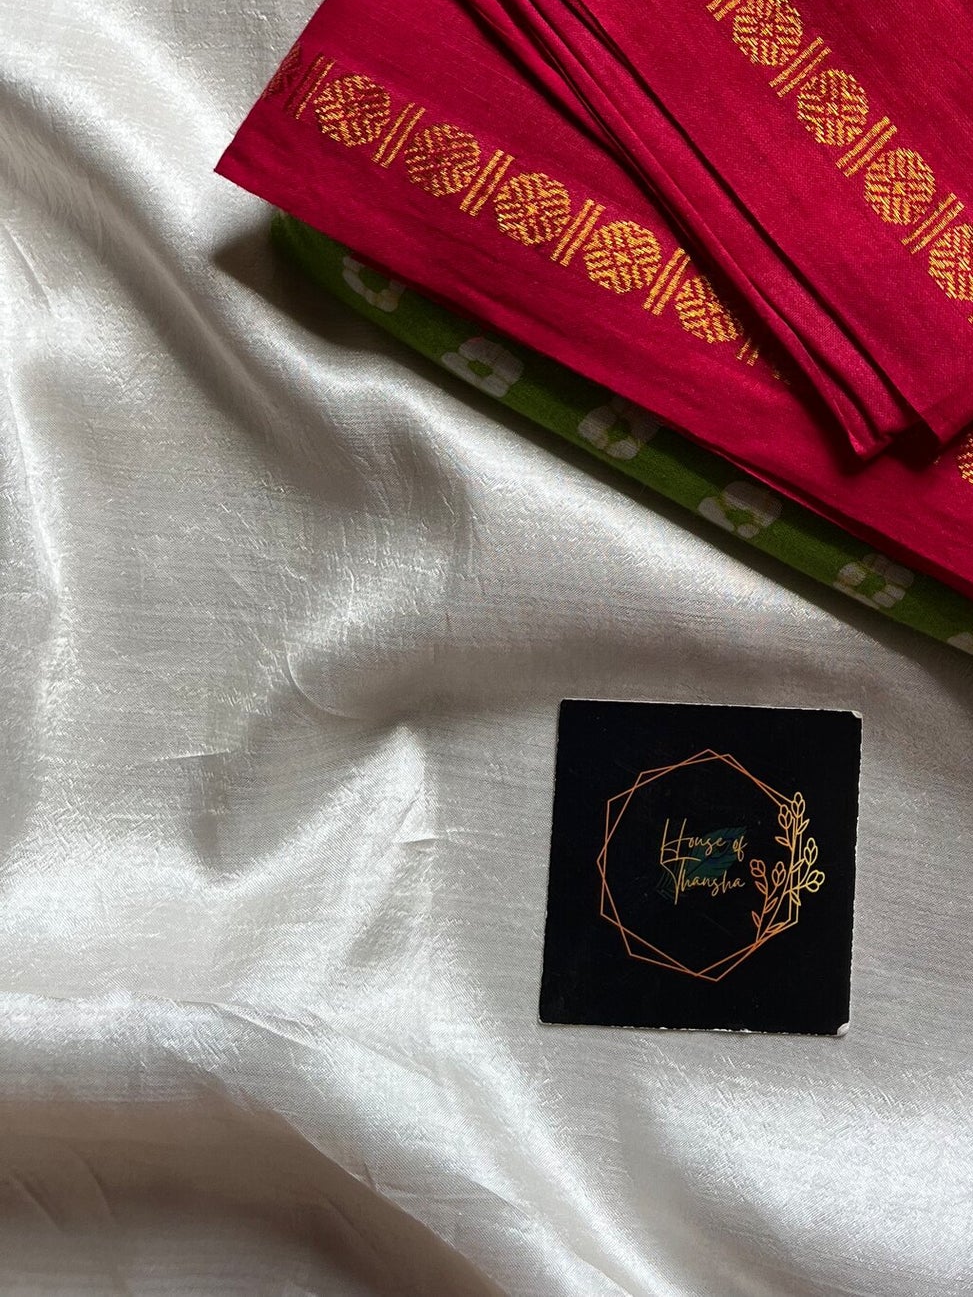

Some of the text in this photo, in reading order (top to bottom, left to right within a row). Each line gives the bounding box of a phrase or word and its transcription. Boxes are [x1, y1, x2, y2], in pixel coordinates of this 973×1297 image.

[660, 817, 749, 862] House of
[660, 855, 746, 905] Thansha
